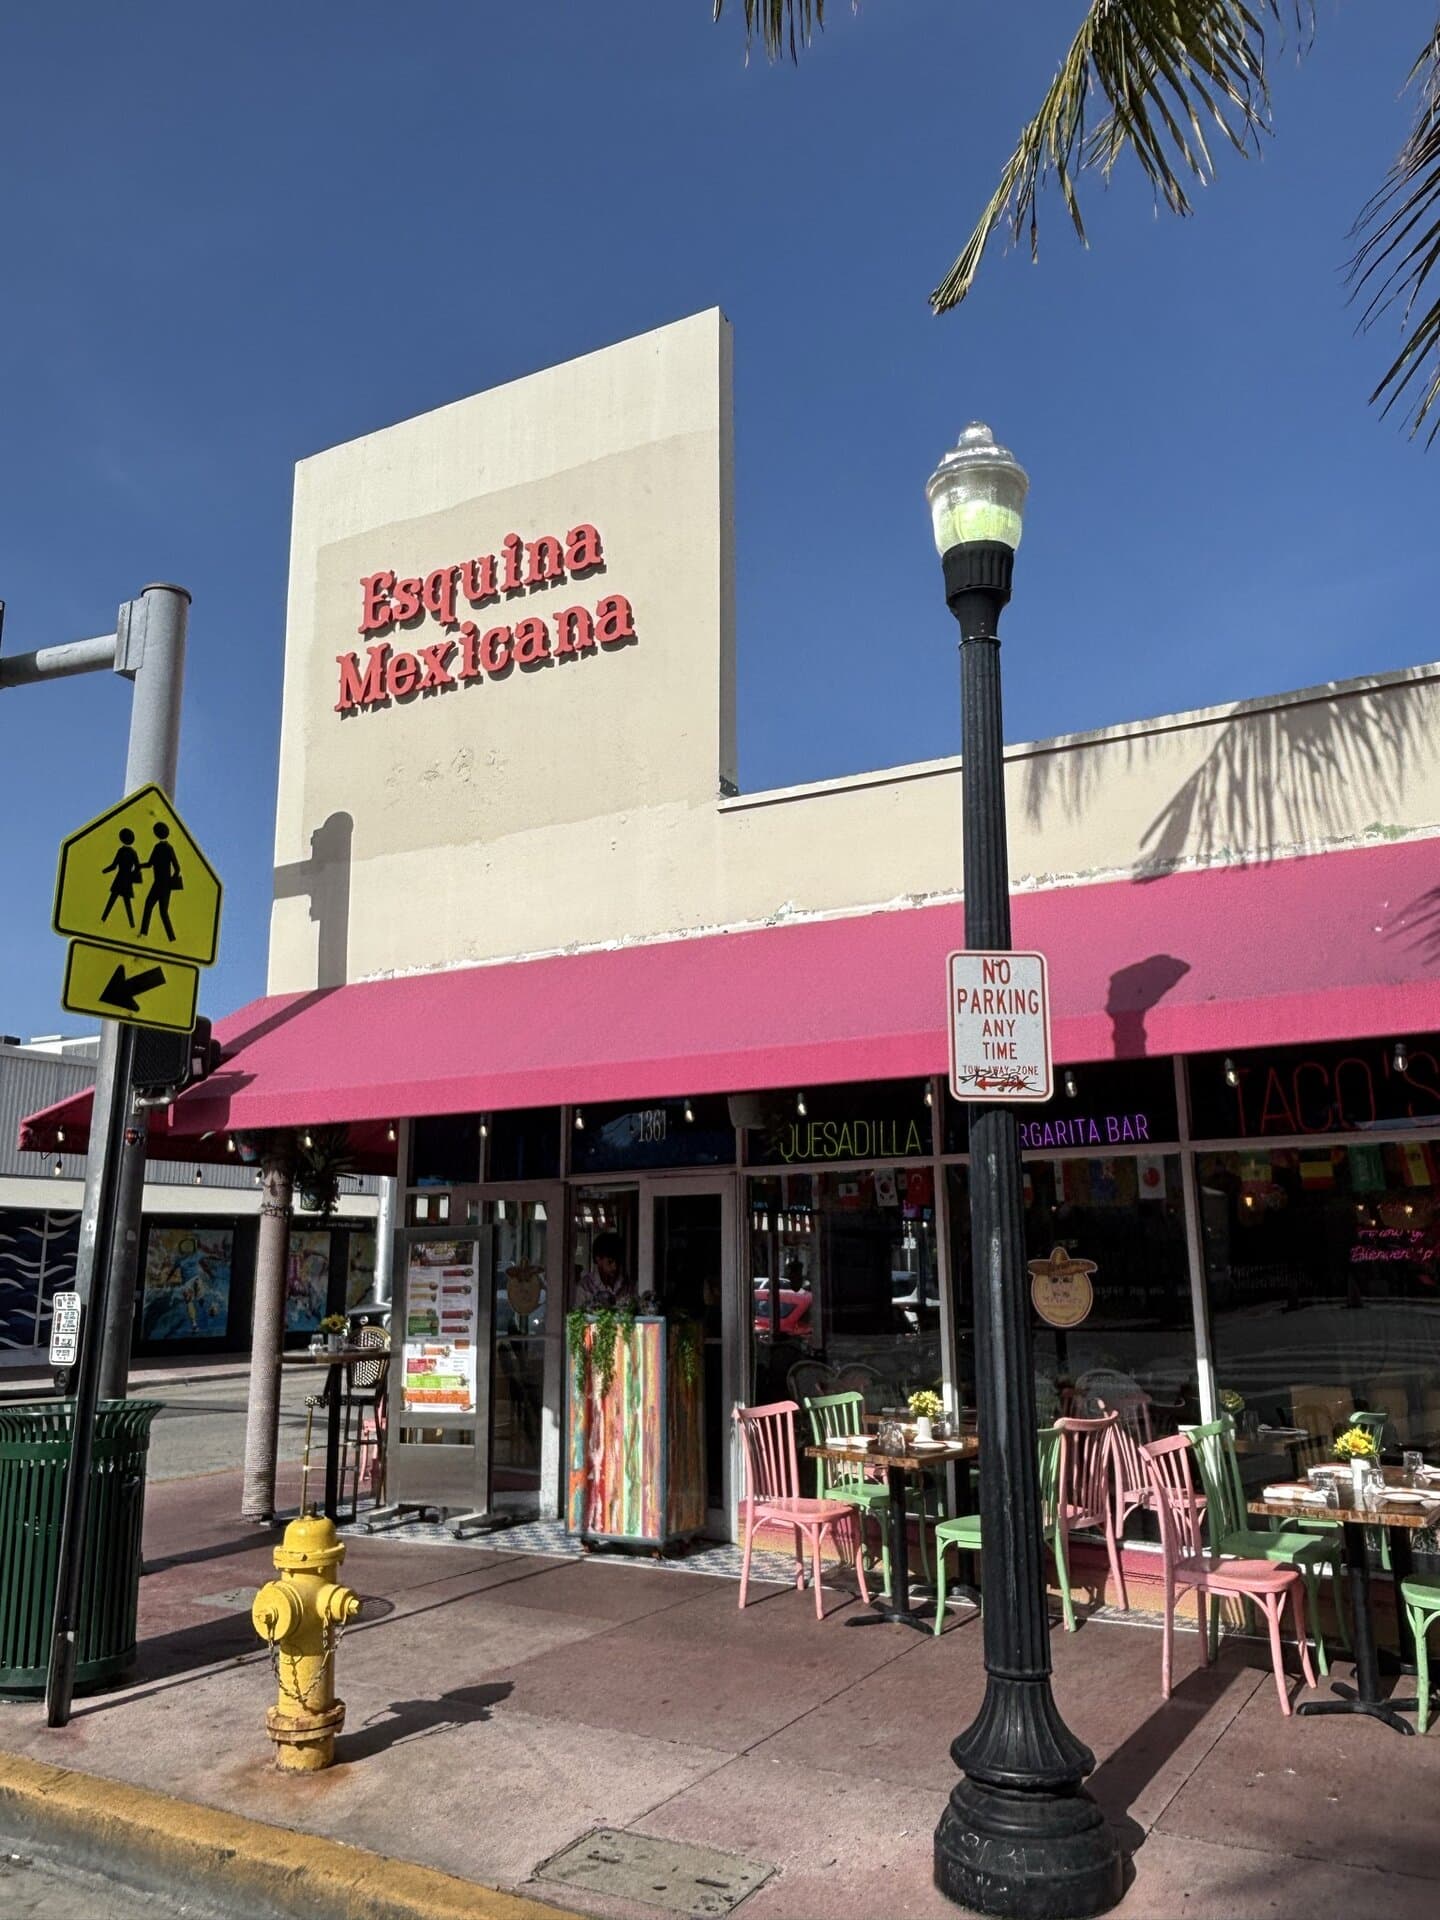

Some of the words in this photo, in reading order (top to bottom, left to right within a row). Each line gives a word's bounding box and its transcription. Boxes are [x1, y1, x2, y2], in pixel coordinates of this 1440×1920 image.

[358, 522, 605, 634] Esquina
[334, 594, 636, 713] Mexicana
[982, 959, 1011, 985] NO
[957, 988, 1039, 1015] PARKING
[982, 1019, 1016, 1037] ANY
[982, 1042, 1018, 1060] TIME
[638, 1109, 667, 1143] 1361
[780, 1119, 922, 1163] QUESADILLA
[1019, 1118, 1101, 1147] RGARITA
[1105, 1113, 1150, 1143] BAR
